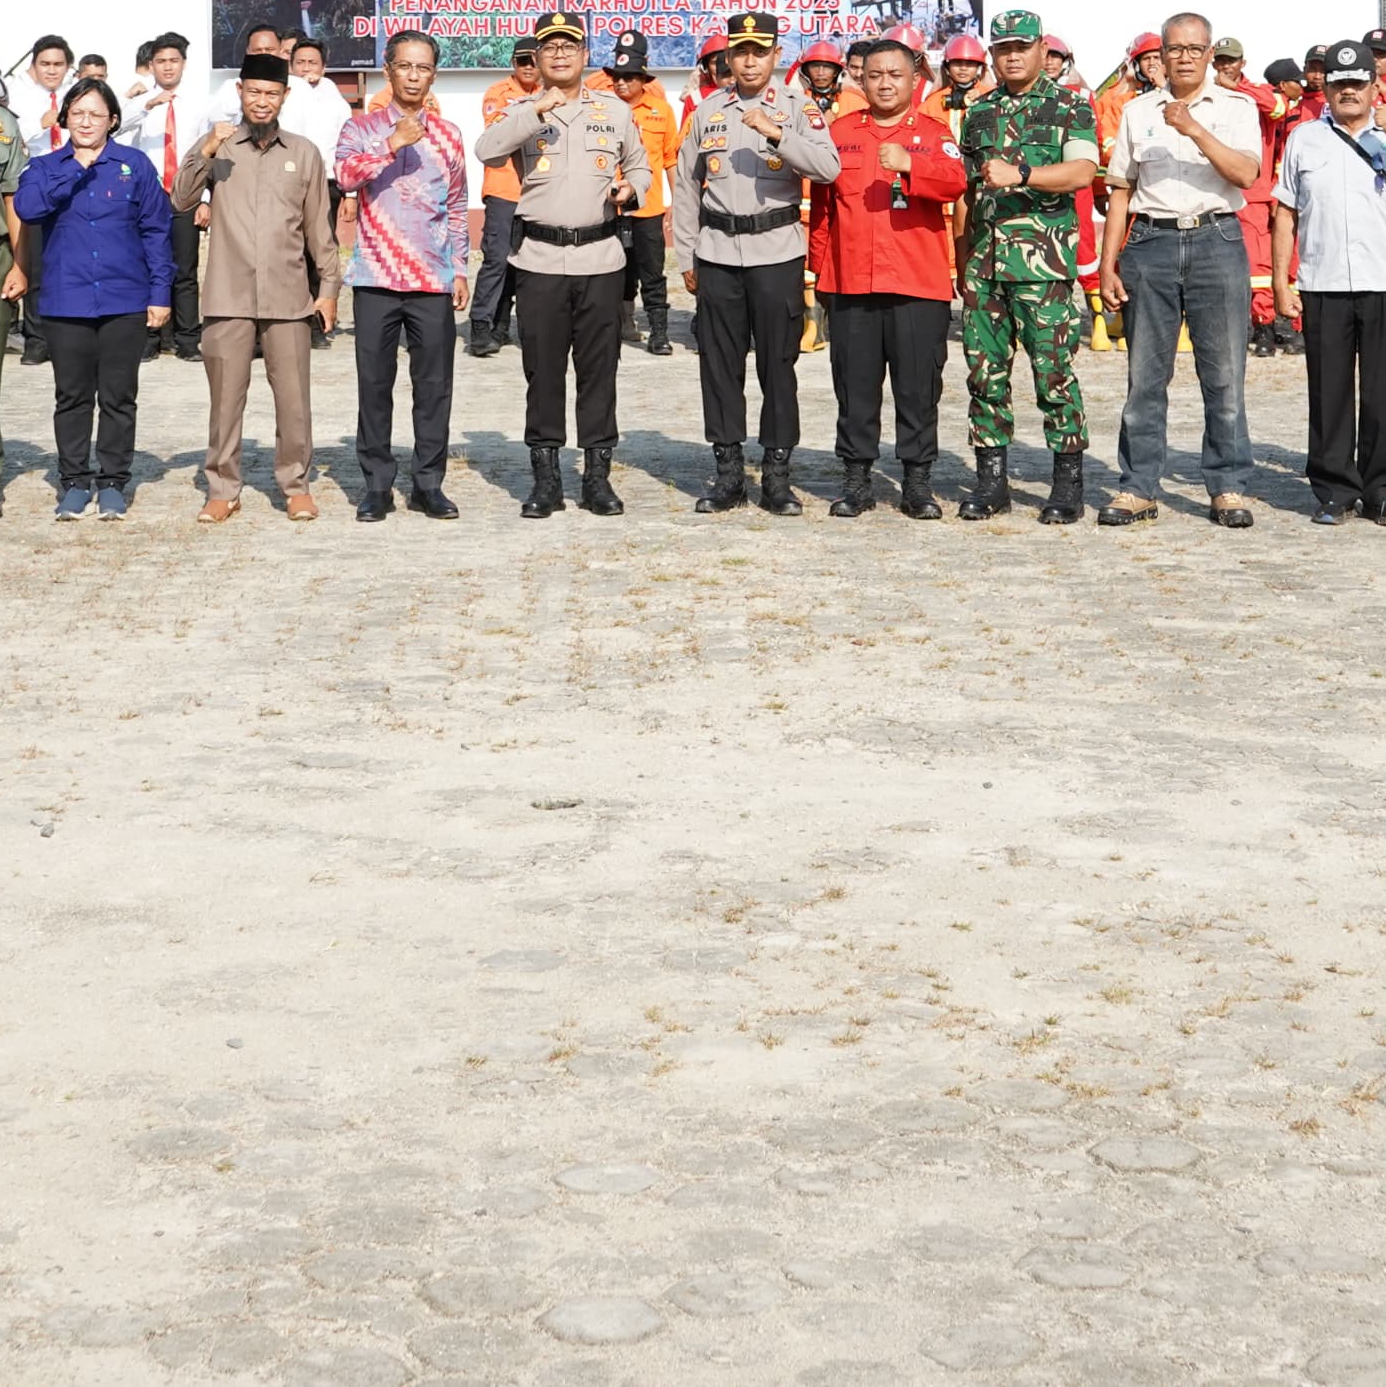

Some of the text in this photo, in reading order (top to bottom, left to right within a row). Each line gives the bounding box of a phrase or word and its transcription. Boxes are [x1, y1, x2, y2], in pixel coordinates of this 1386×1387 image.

[354, 17, 377, 37] DI
[383, 16, 490, 37] WILAYAH
[594, 15, 684, 36] POLRES
[799, 14, 878, 35] UTARA
[586, 125, 615, 133] POLRI
[704, 124, 728, 134] ARIS
